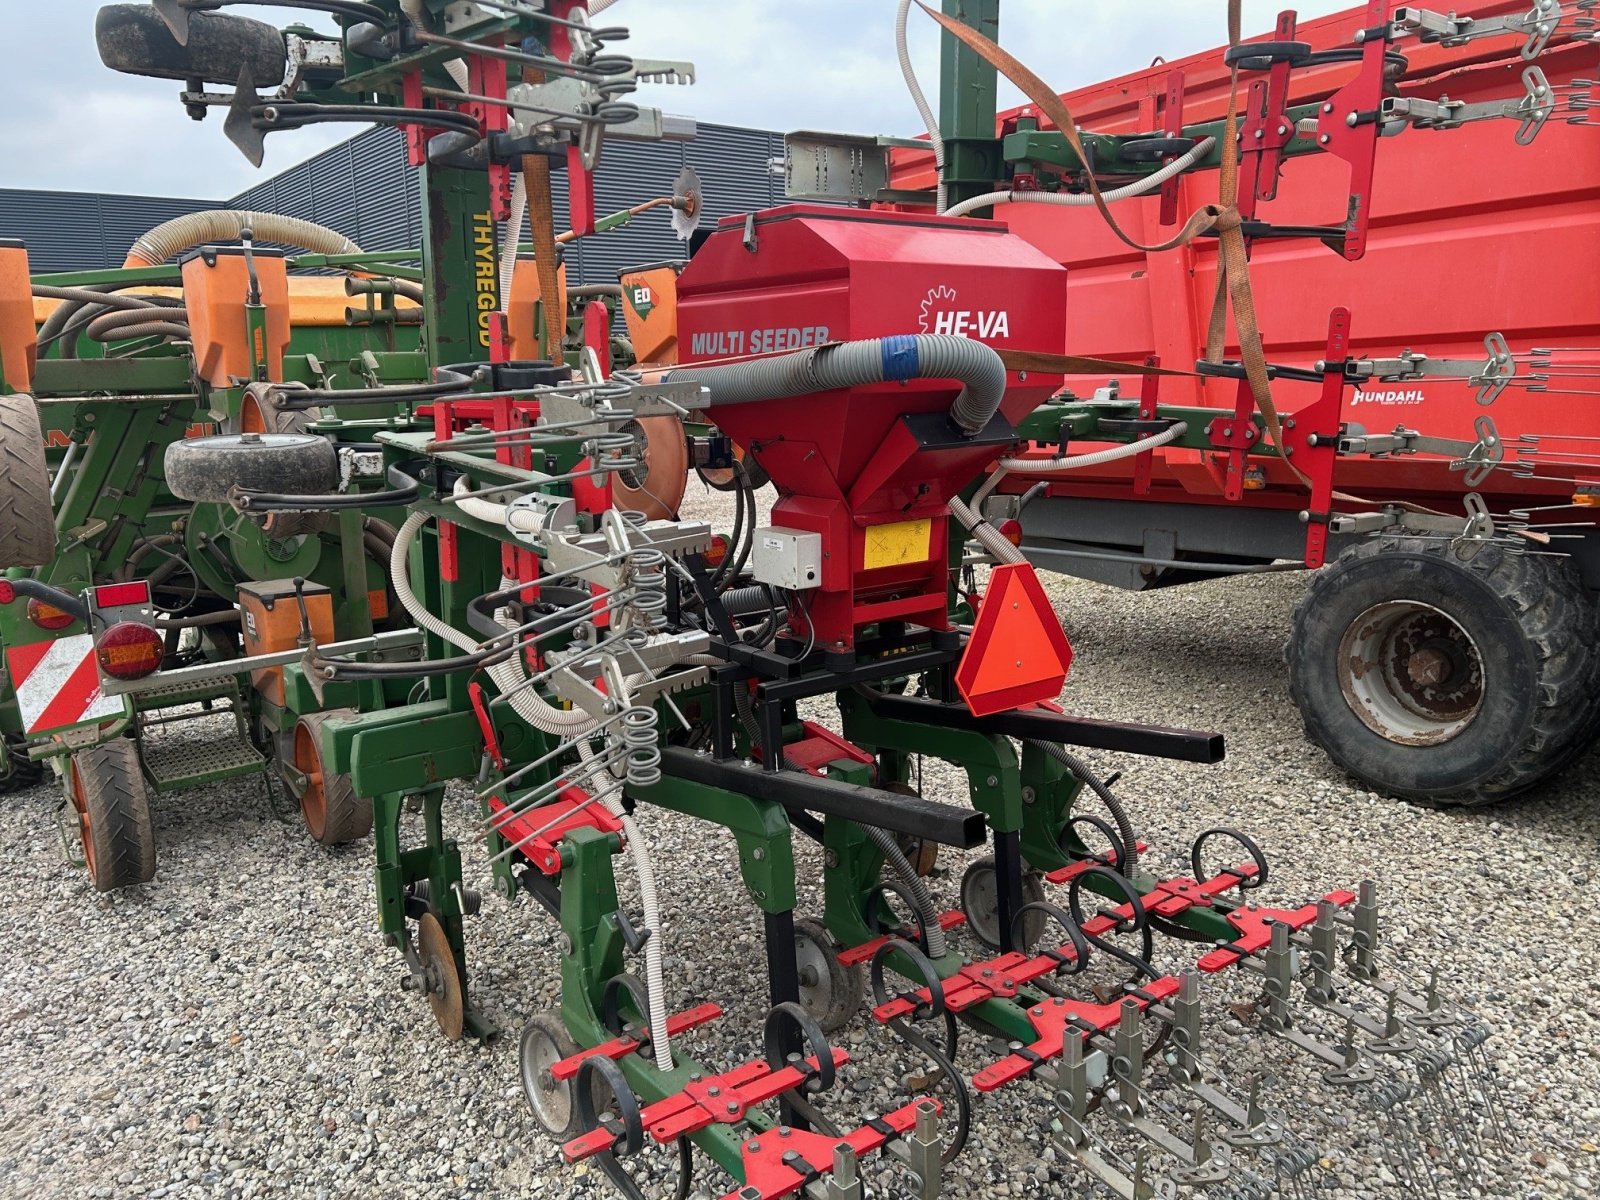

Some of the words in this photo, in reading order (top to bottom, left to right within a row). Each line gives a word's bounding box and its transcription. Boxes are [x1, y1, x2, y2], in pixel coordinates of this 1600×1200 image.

[634, 287, 650, 304] ED
[934, 311, 1009, 338] HE-VA
[692, 331, 744, 355] MULTI
[749, 326, 829, 353] SEEDER
